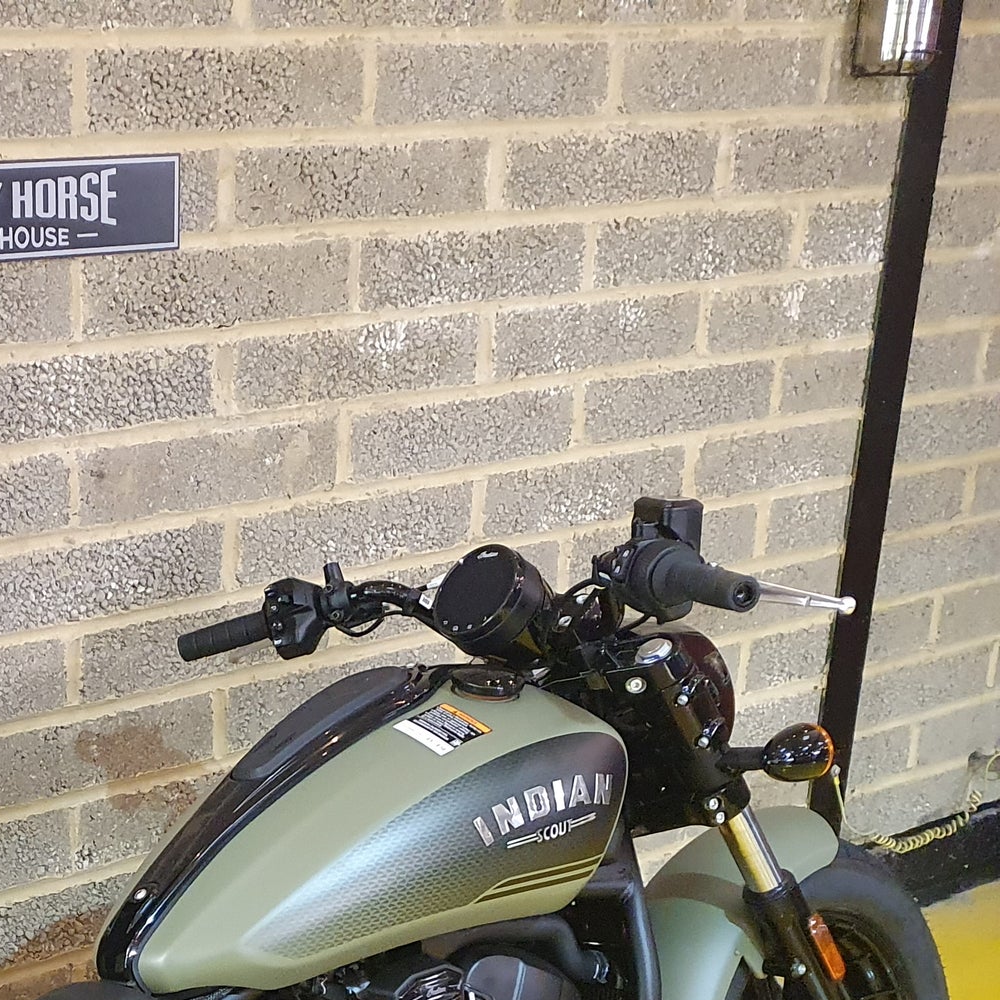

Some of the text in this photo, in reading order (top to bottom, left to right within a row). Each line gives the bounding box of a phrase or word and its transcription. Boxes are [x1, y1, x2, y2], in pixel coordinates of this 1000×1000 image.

[12, 167, 117, 226] HORSE
[0, 226, 70, 250] HOUSE
[472, 772, 613, 847] INDIAN
[535, 817, 575, 844] SCOUT
